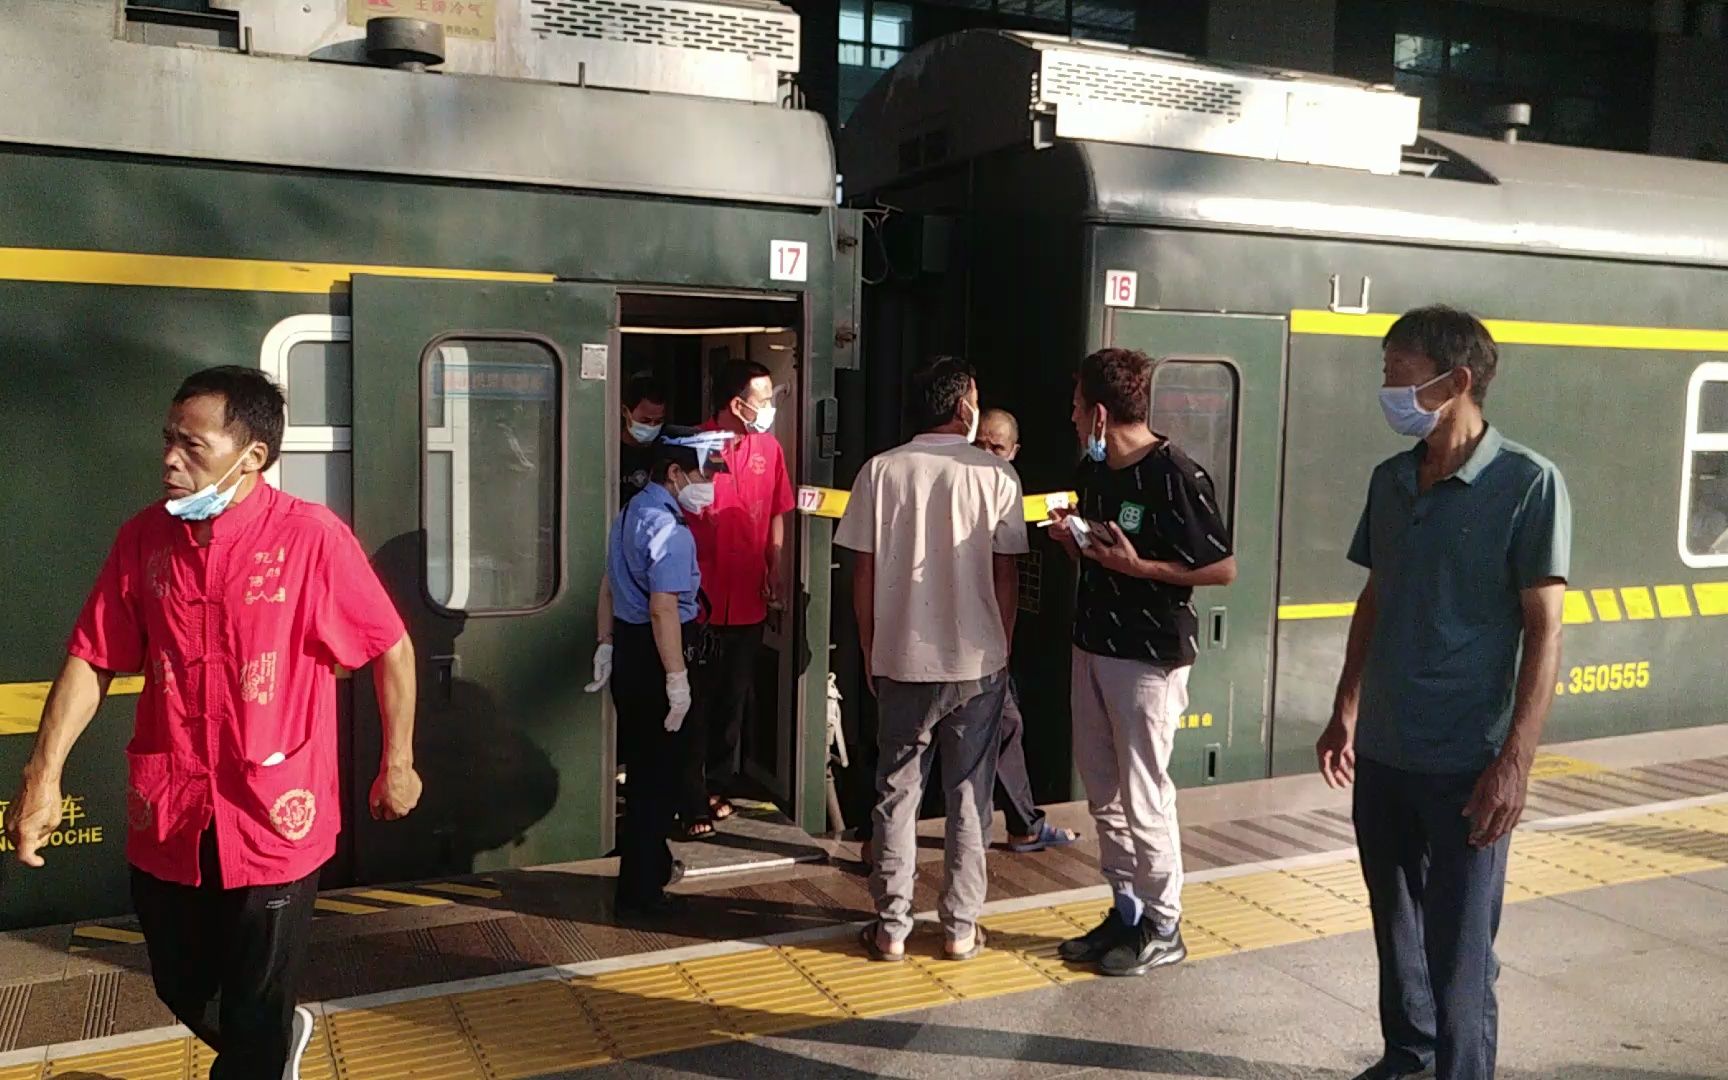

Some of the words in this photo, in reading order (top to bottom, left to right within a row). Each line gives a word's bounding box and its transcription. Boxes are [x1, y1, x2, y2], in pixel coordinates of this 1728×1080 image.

[777, 246, 801, 275] 17
[1111, 275, 1131, 301] 16
[802, 491, 816, 508] 17
[1568, 661, 1650, 694] 350555
